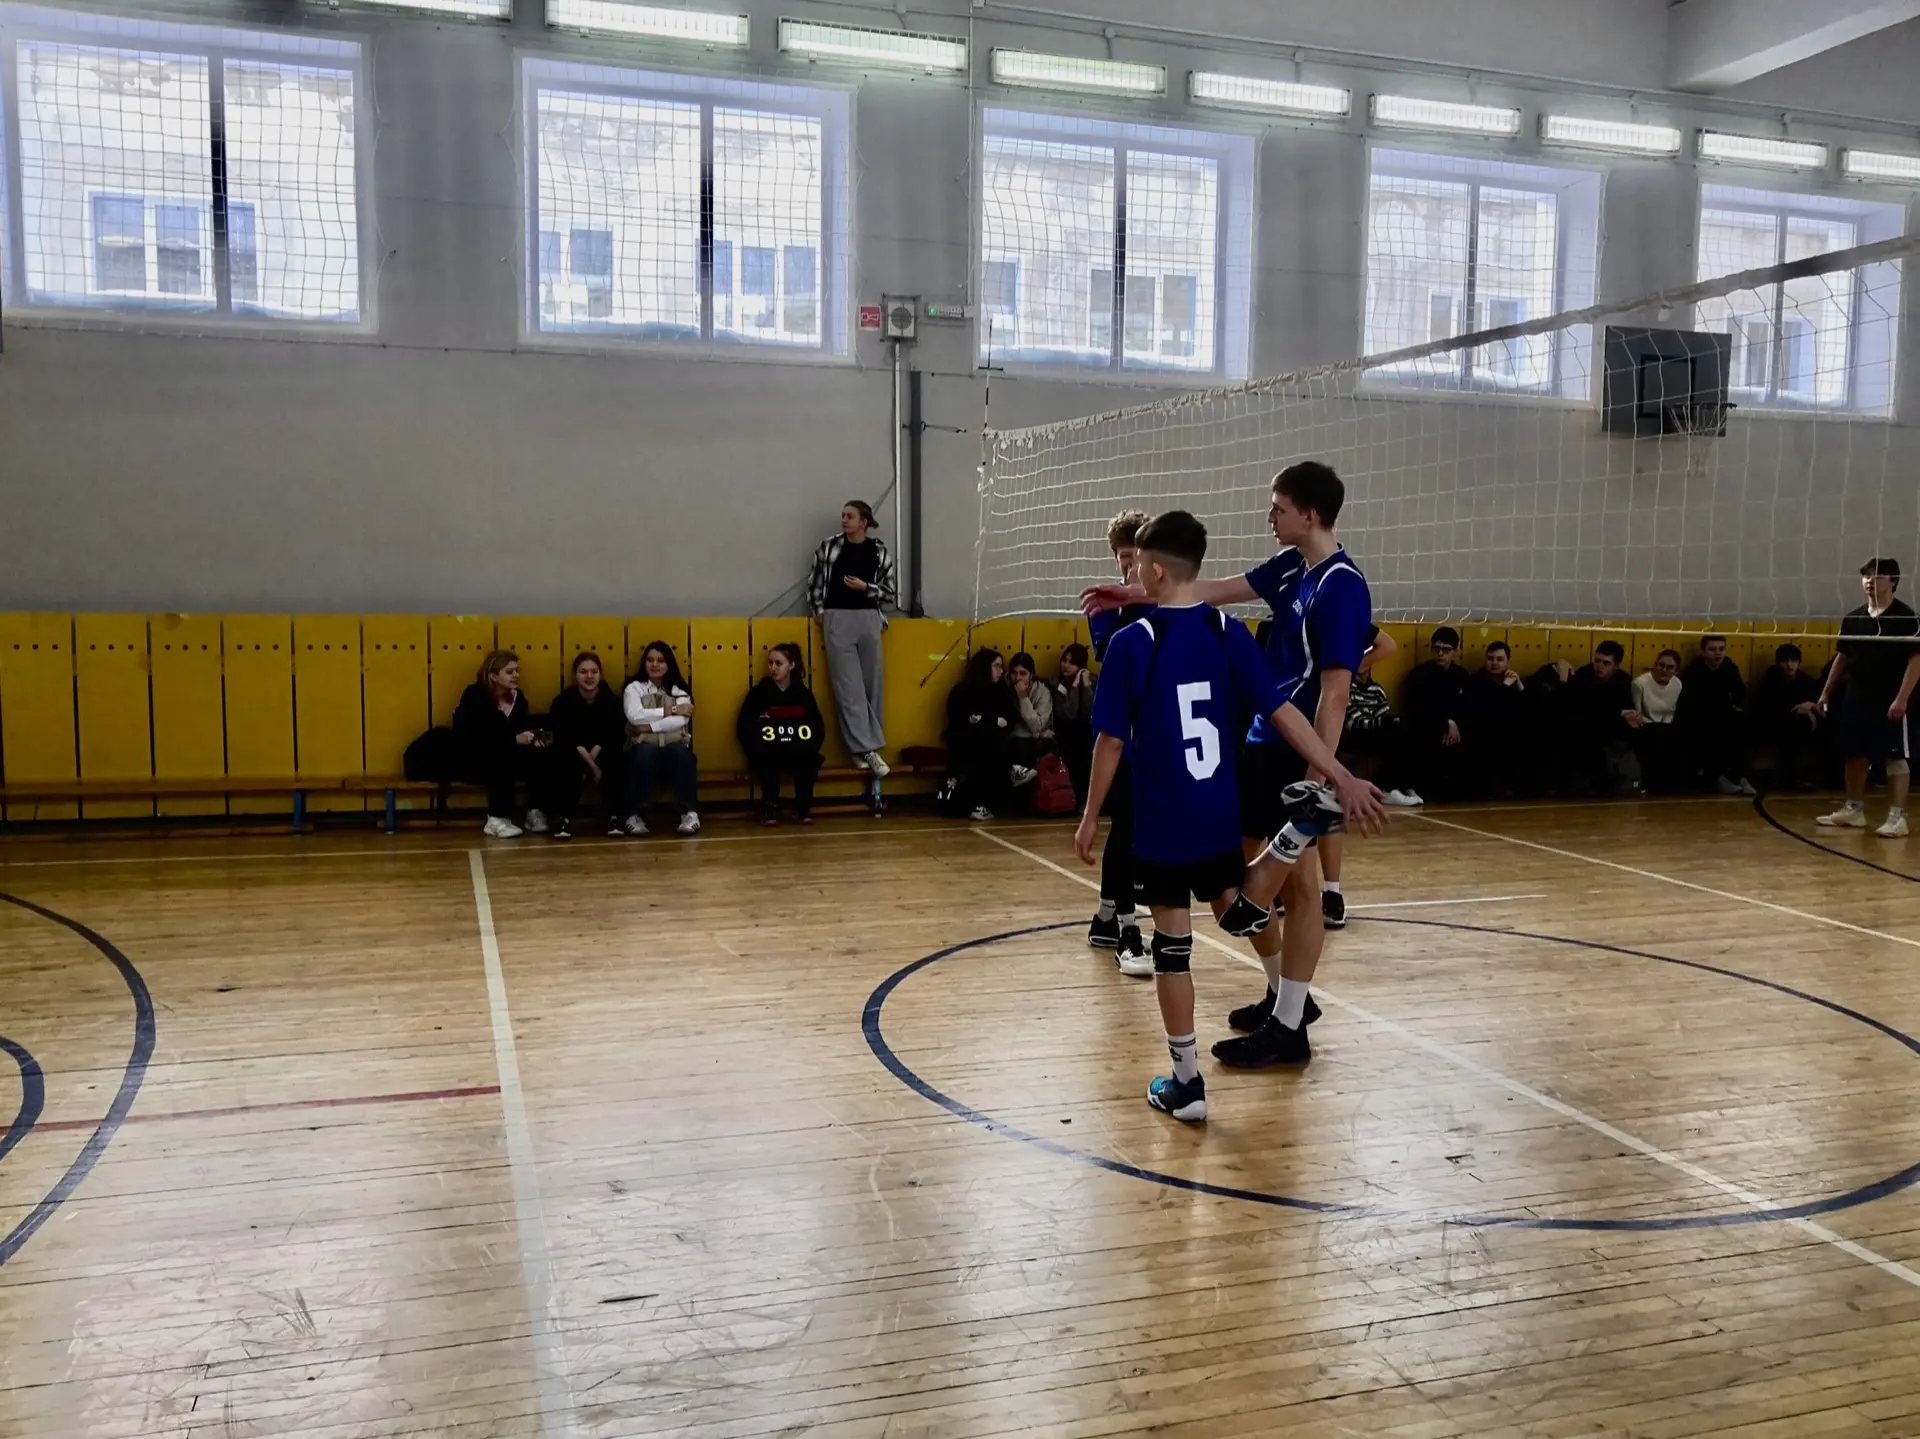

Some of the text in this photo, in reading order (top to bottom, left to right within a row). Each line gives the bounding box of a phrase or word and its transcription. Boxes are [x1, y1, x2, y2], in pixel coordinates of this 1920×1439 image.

[762, 726, 776, 741] 3
[798, 725, 812, 740] 0
[1176, 681, 1221, 781] 5
